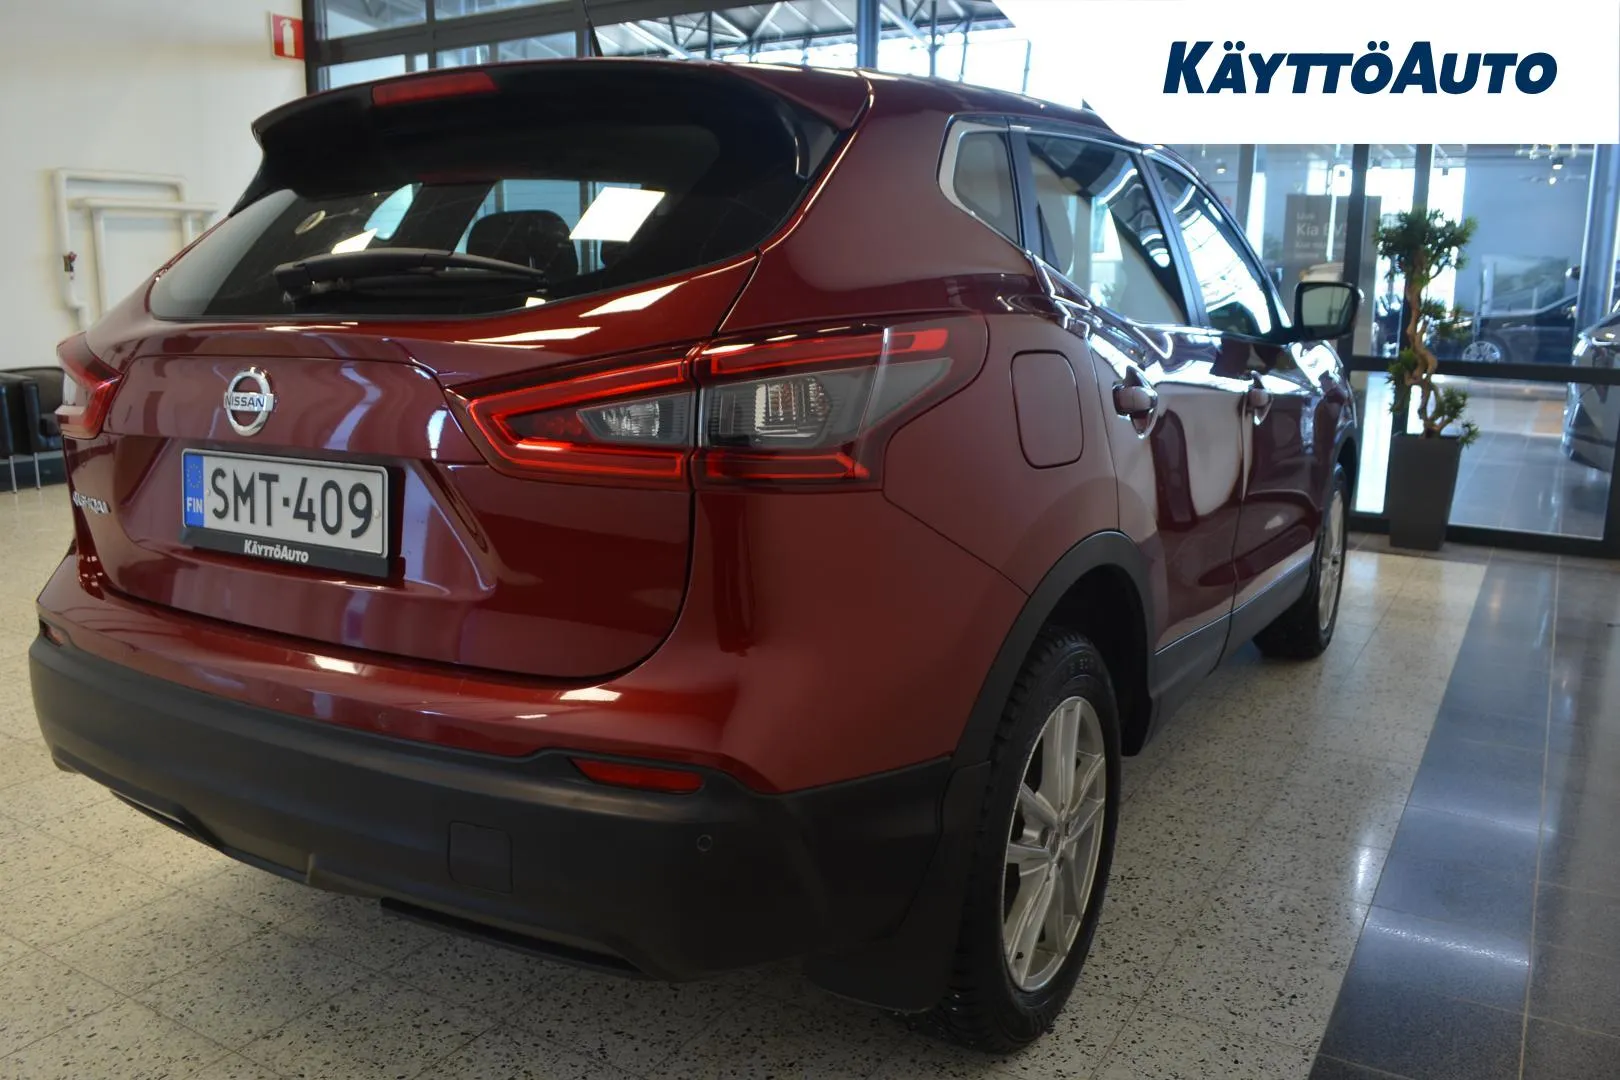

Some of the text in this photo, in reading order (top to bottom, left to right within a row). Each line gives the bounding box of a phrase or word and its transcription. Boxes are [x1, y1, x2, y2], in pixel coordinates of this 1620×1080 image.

[1296, 222, 1319, 236] Kia
[225, 396, 265, 408] NISSAN
[186, 467, 373, 539] FIN SMT-409
